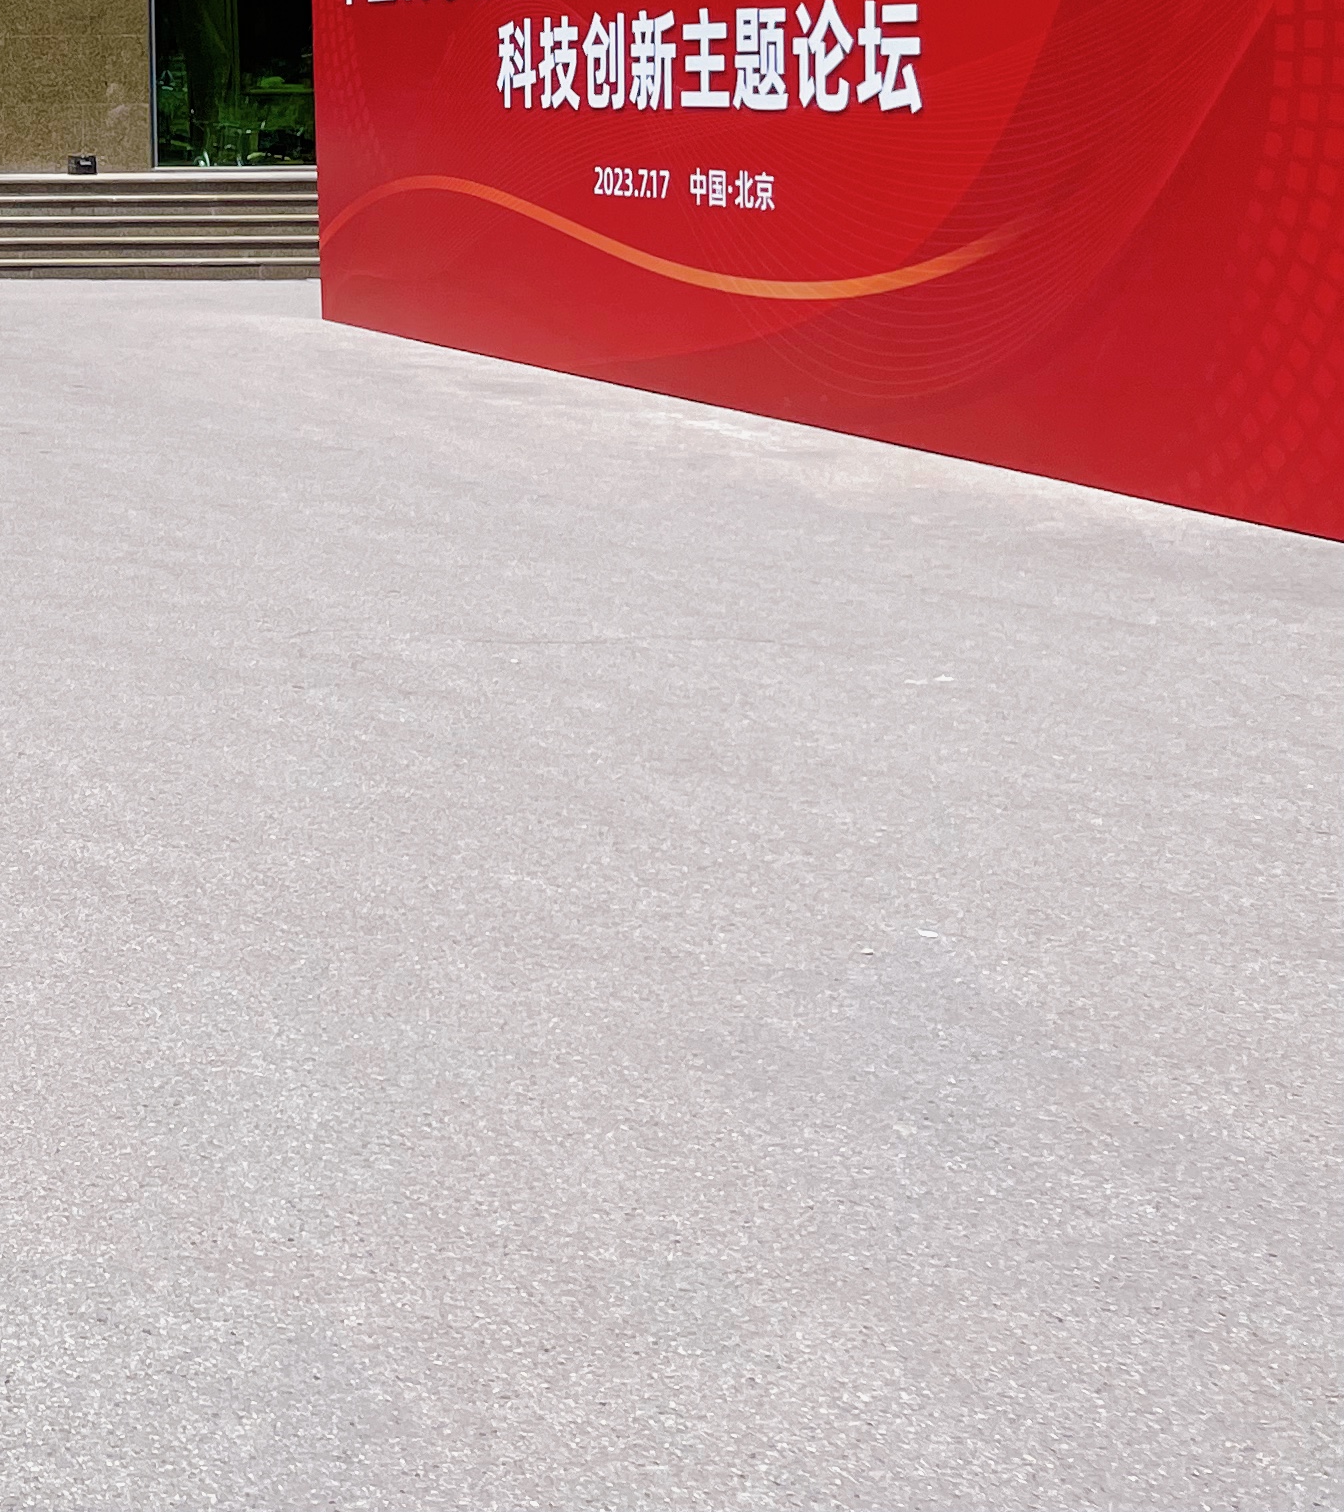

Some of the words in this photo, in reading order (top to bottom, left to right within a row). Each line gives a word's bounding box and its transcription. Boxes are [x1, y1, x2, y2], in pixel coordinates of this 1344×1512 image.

[594, 166, 670, 199] 2023.7.17
[689, 167, 775, 210] 中国·北京
